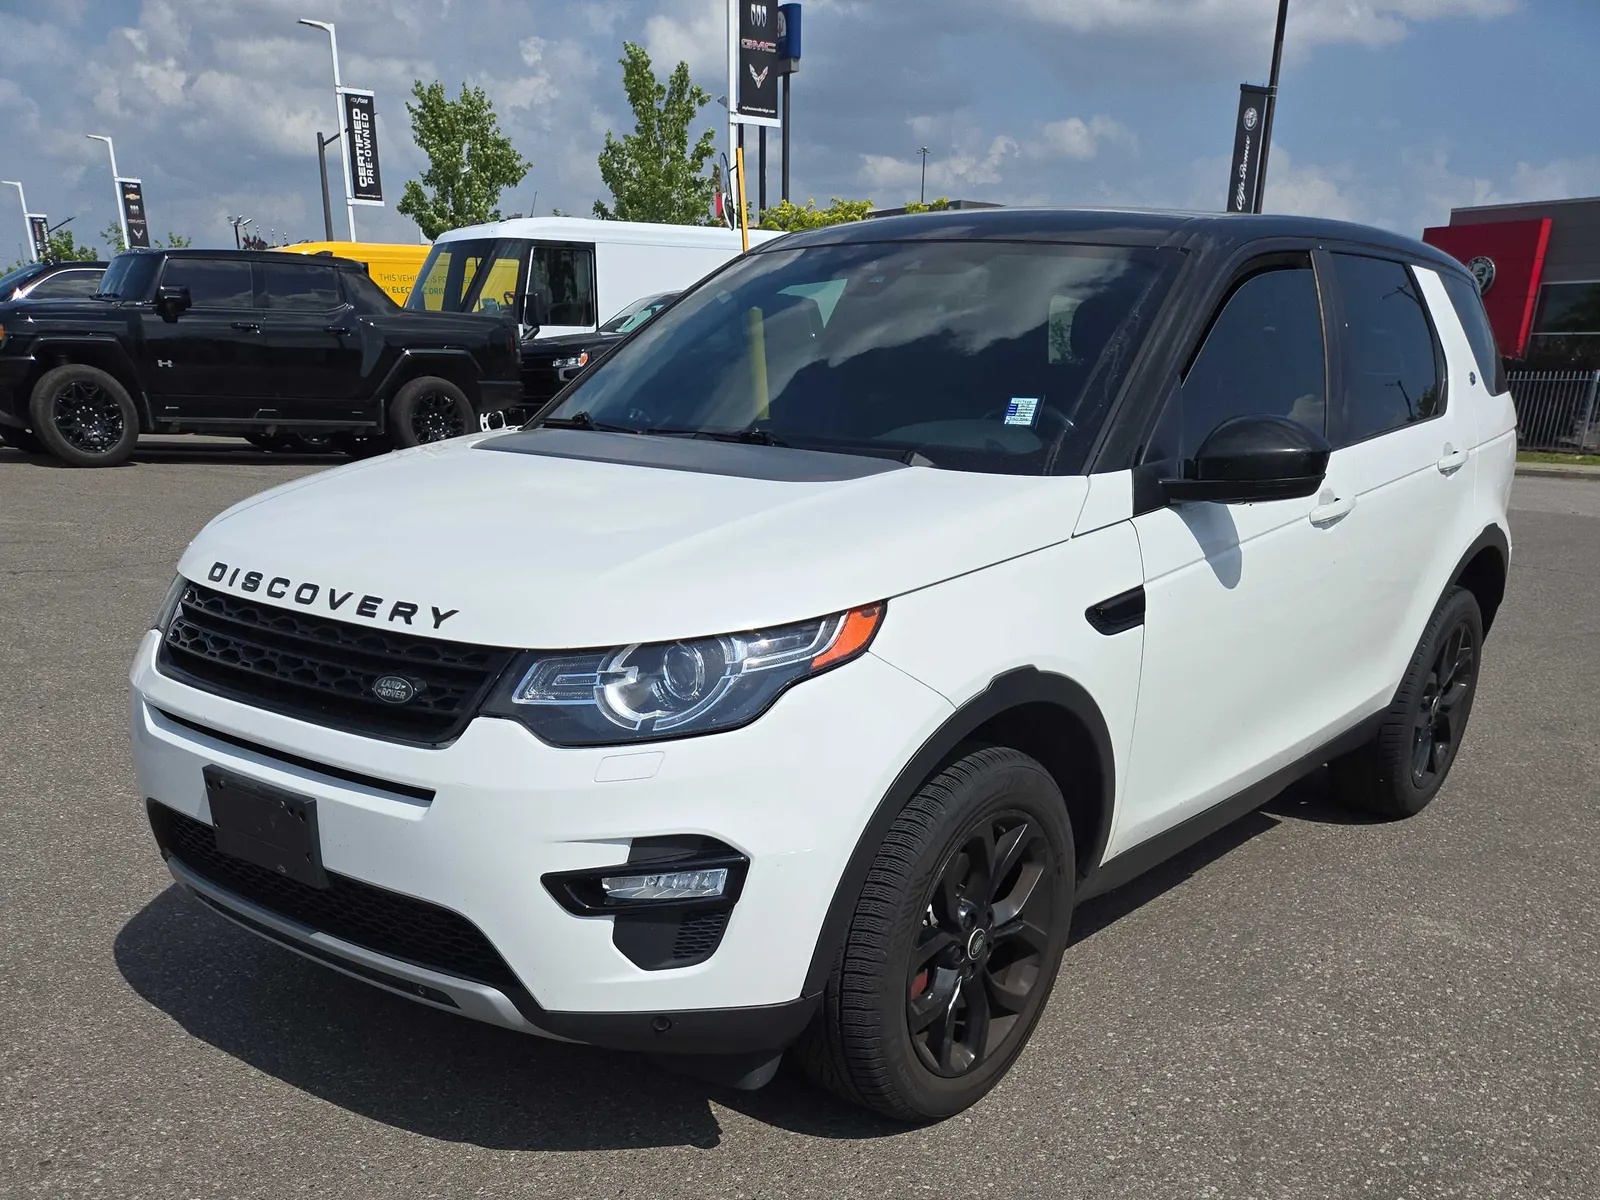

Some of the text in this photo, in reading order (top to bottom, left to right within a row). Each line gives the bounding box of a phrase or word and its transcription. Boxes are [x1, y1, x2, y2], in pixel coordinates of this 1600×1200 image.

[740, 38, 776, 53] GMC
[352, 108, 368, 188] CERTIFIED
[361, 112, 375, 185] PRE-OWNED
[1236, 134, 1250, 211] Alfa Romeo
[378, 273, 397, 282] THIS
[207, 561, 460, 630] DISCOVERY
[380, 679, 402, 690] LAND
[380, 687, 407, 700] ROVER
